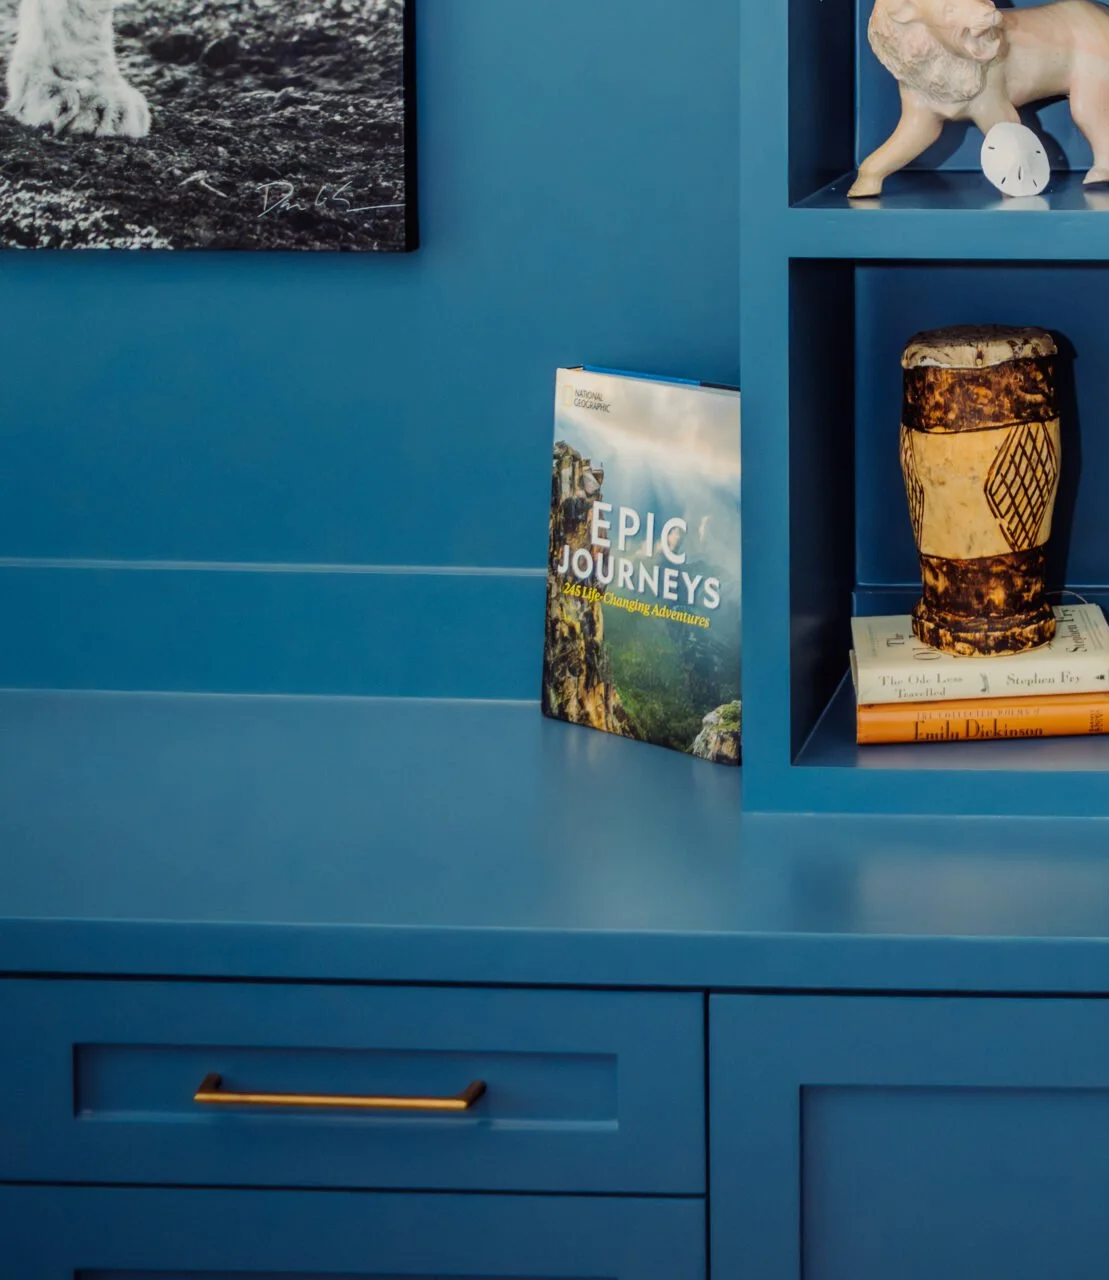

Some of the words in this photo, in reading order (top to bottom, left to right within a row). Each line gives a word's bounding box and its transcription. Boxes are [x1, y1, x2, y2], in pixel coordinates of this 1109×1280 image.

[574, 389, 604, 402] NATIONAL
[573, 398, 611, 413] GEOGRAPHIC
[591, 500, 687, 565] EPIC
[557, 544, 720, 609] JOURNEYS
[563, 581, 582, 597] 245
[581, 586, 651, 617] Life-Changing
[650, 603, 711, 629] Adventures
[878, 675, 902, 686] The
[908, 673, 929, 685] Ode
[937, 672, 963, 684] Less
[1006, 671, 1055, 687] Stephen
[1061, 671, 1080, 684] Fry
[895, 687, 946, 698] Travelled
[964, 718, 1044, 738] Dickinson
